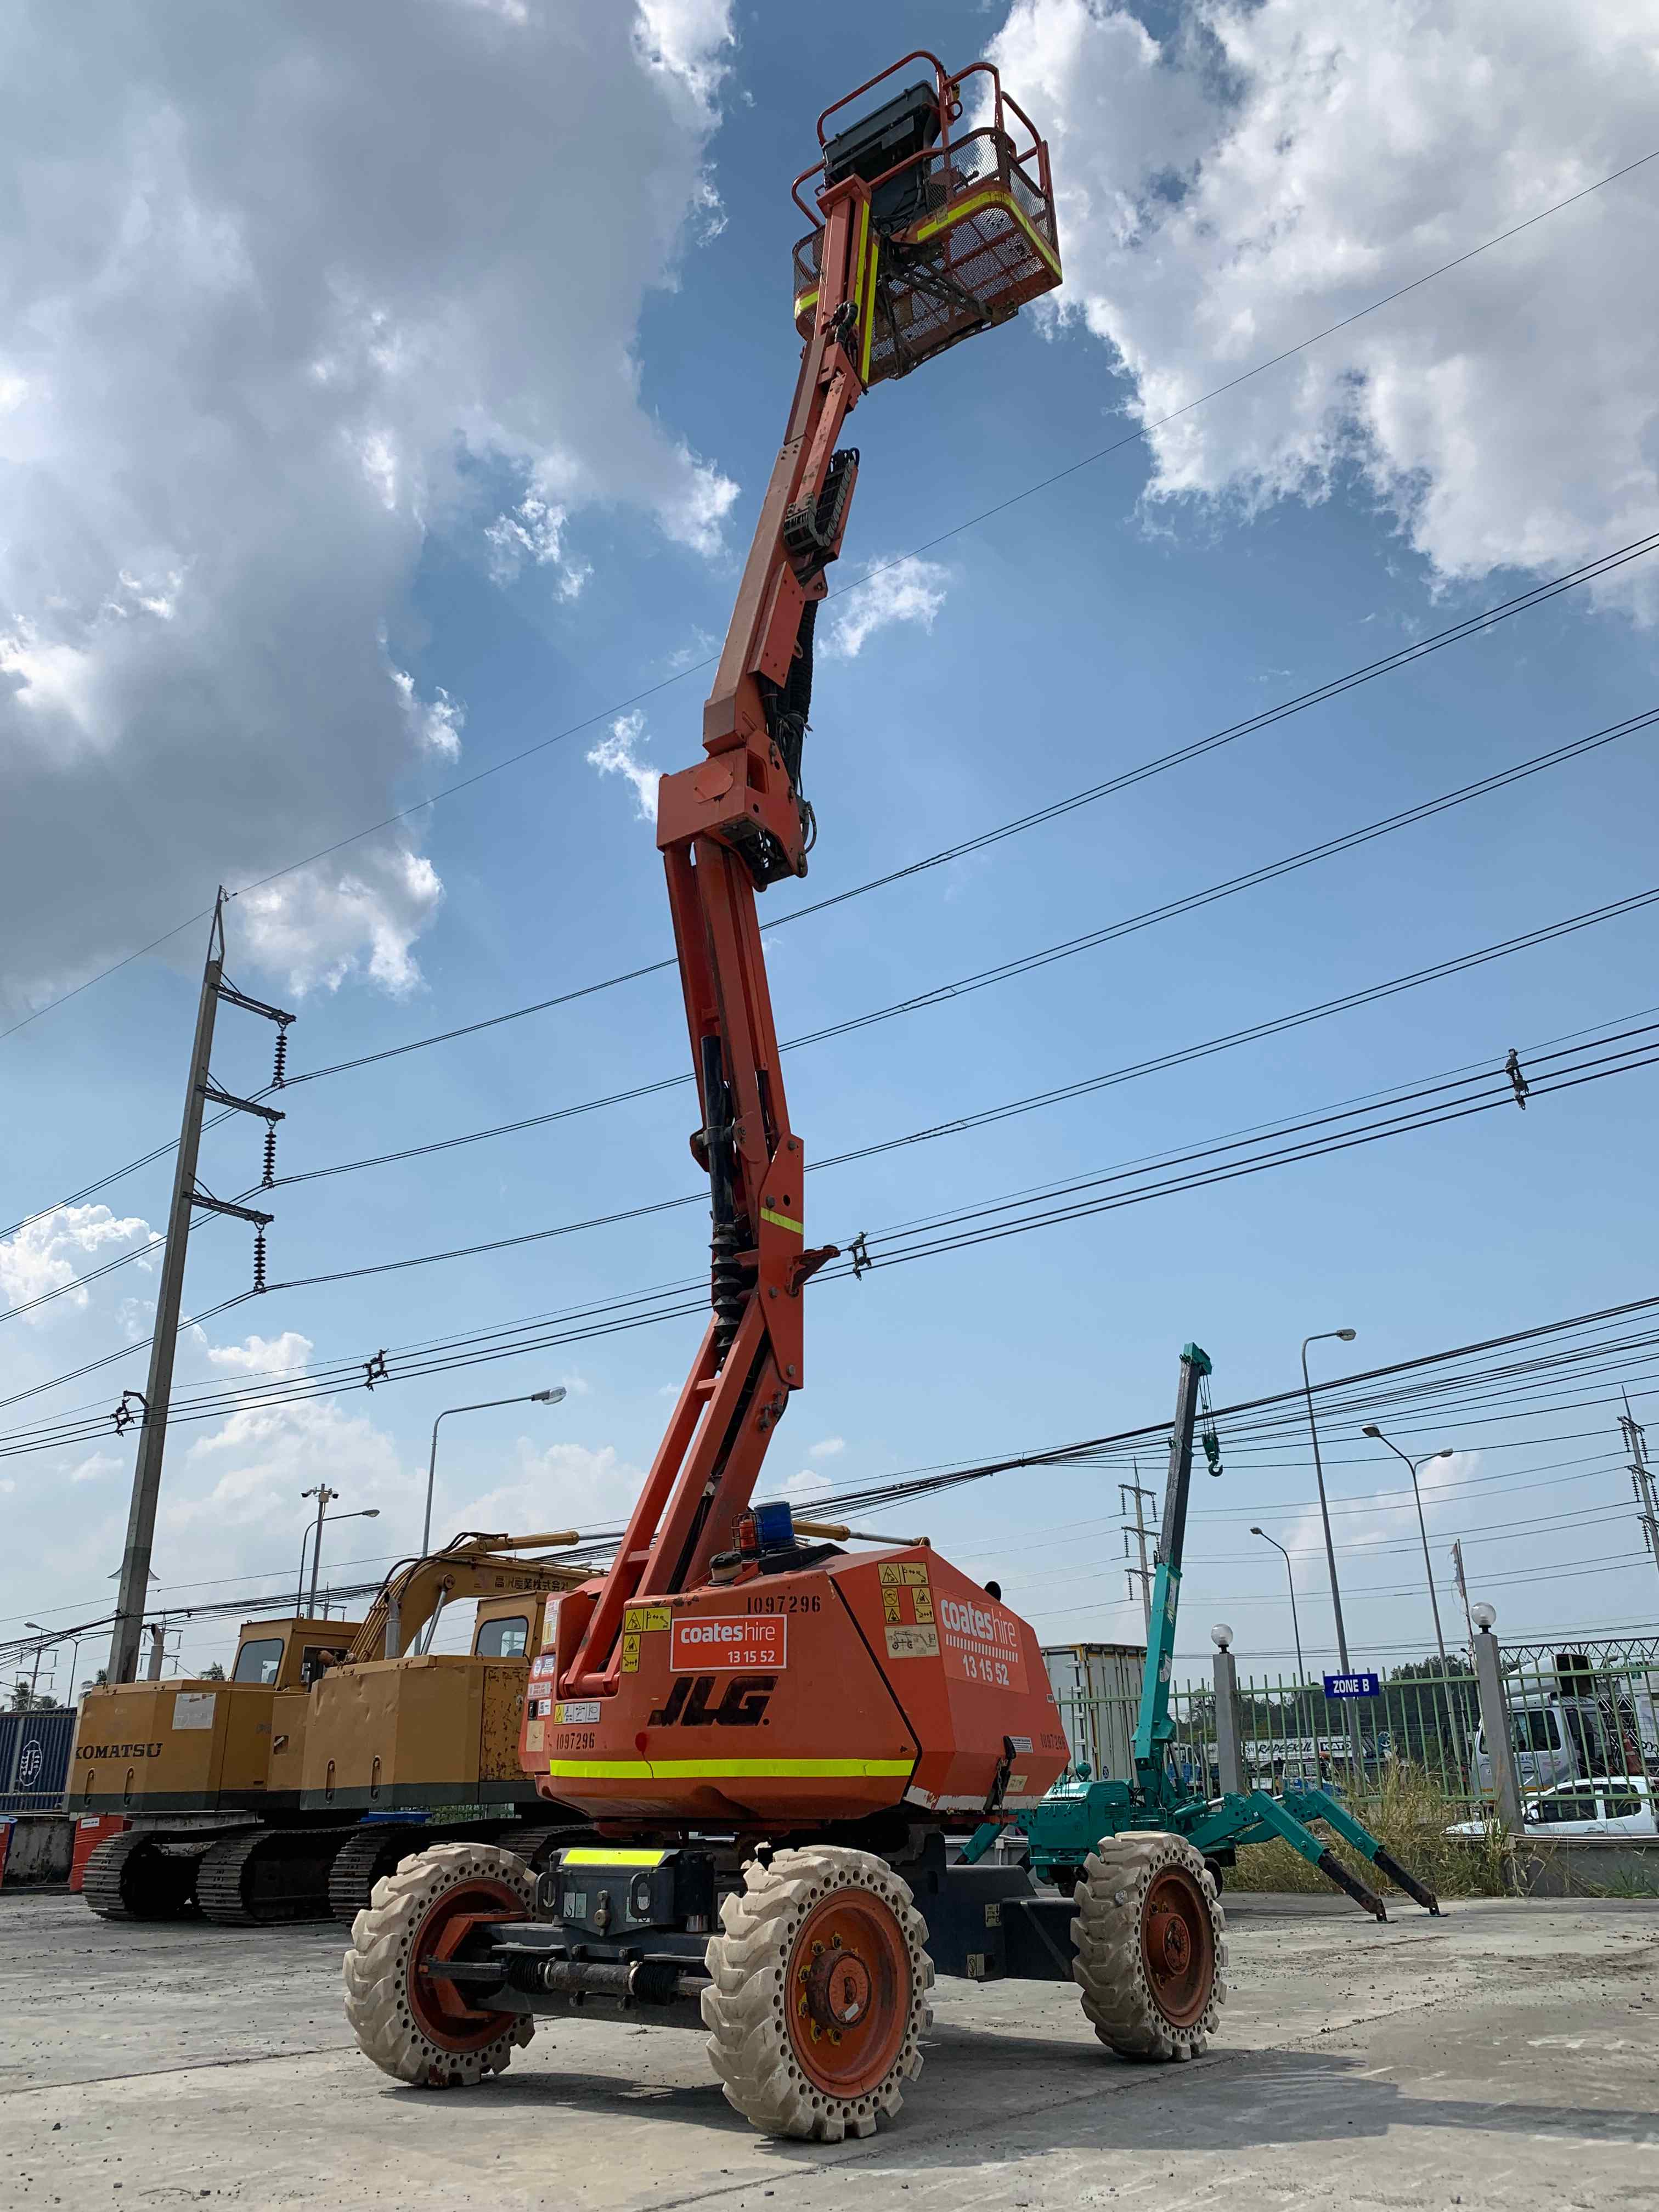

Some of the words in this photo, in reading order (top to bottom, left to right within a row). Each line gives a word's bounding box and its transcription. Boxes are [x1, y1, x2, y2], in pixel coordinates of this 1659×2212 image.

[747, 1595, 821, 1614] 1097296
[728, 1650, 741, 1663] 13
[743, 1650, 757, 1663] 15
[760, 1650, 775, 1663] 52
[963, 1654, 978, 1678] 13
[979, 1659, 993, 1683] 15
[995, 1662, 1009, 1686] 52
[1333, 1679, 1359, 1694] ZONE
[1362, 1679, 1370, 1692] B
[557, 1732, 595, 1750] 1097296
